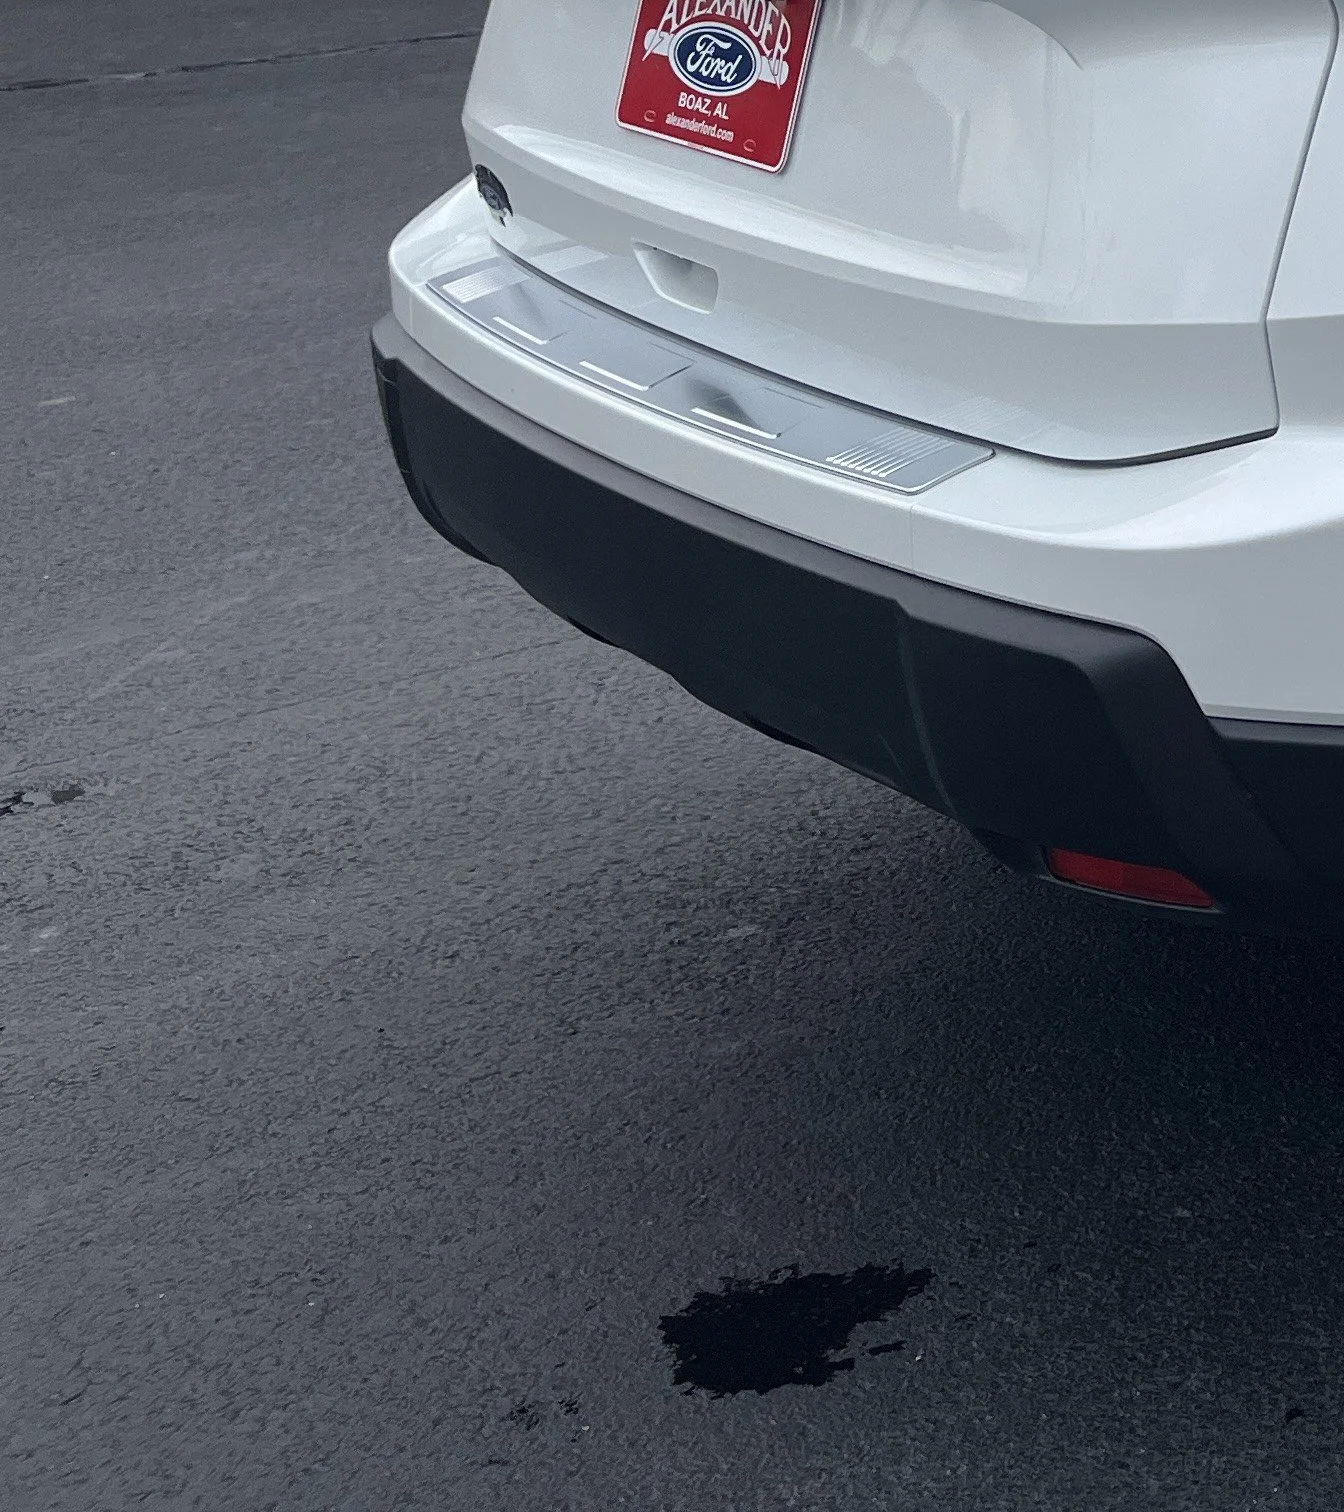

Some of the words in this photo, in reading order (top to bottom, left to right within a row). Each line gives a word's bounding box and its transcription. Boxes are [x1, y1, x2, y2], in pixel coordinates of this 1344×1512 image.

[686, 33, 743, 84] Ford
[677, 91, 713, 118] BOAZ,
[712, 101, 730, 121] AL
[665, 111, 735, 143] alexanderford.com
